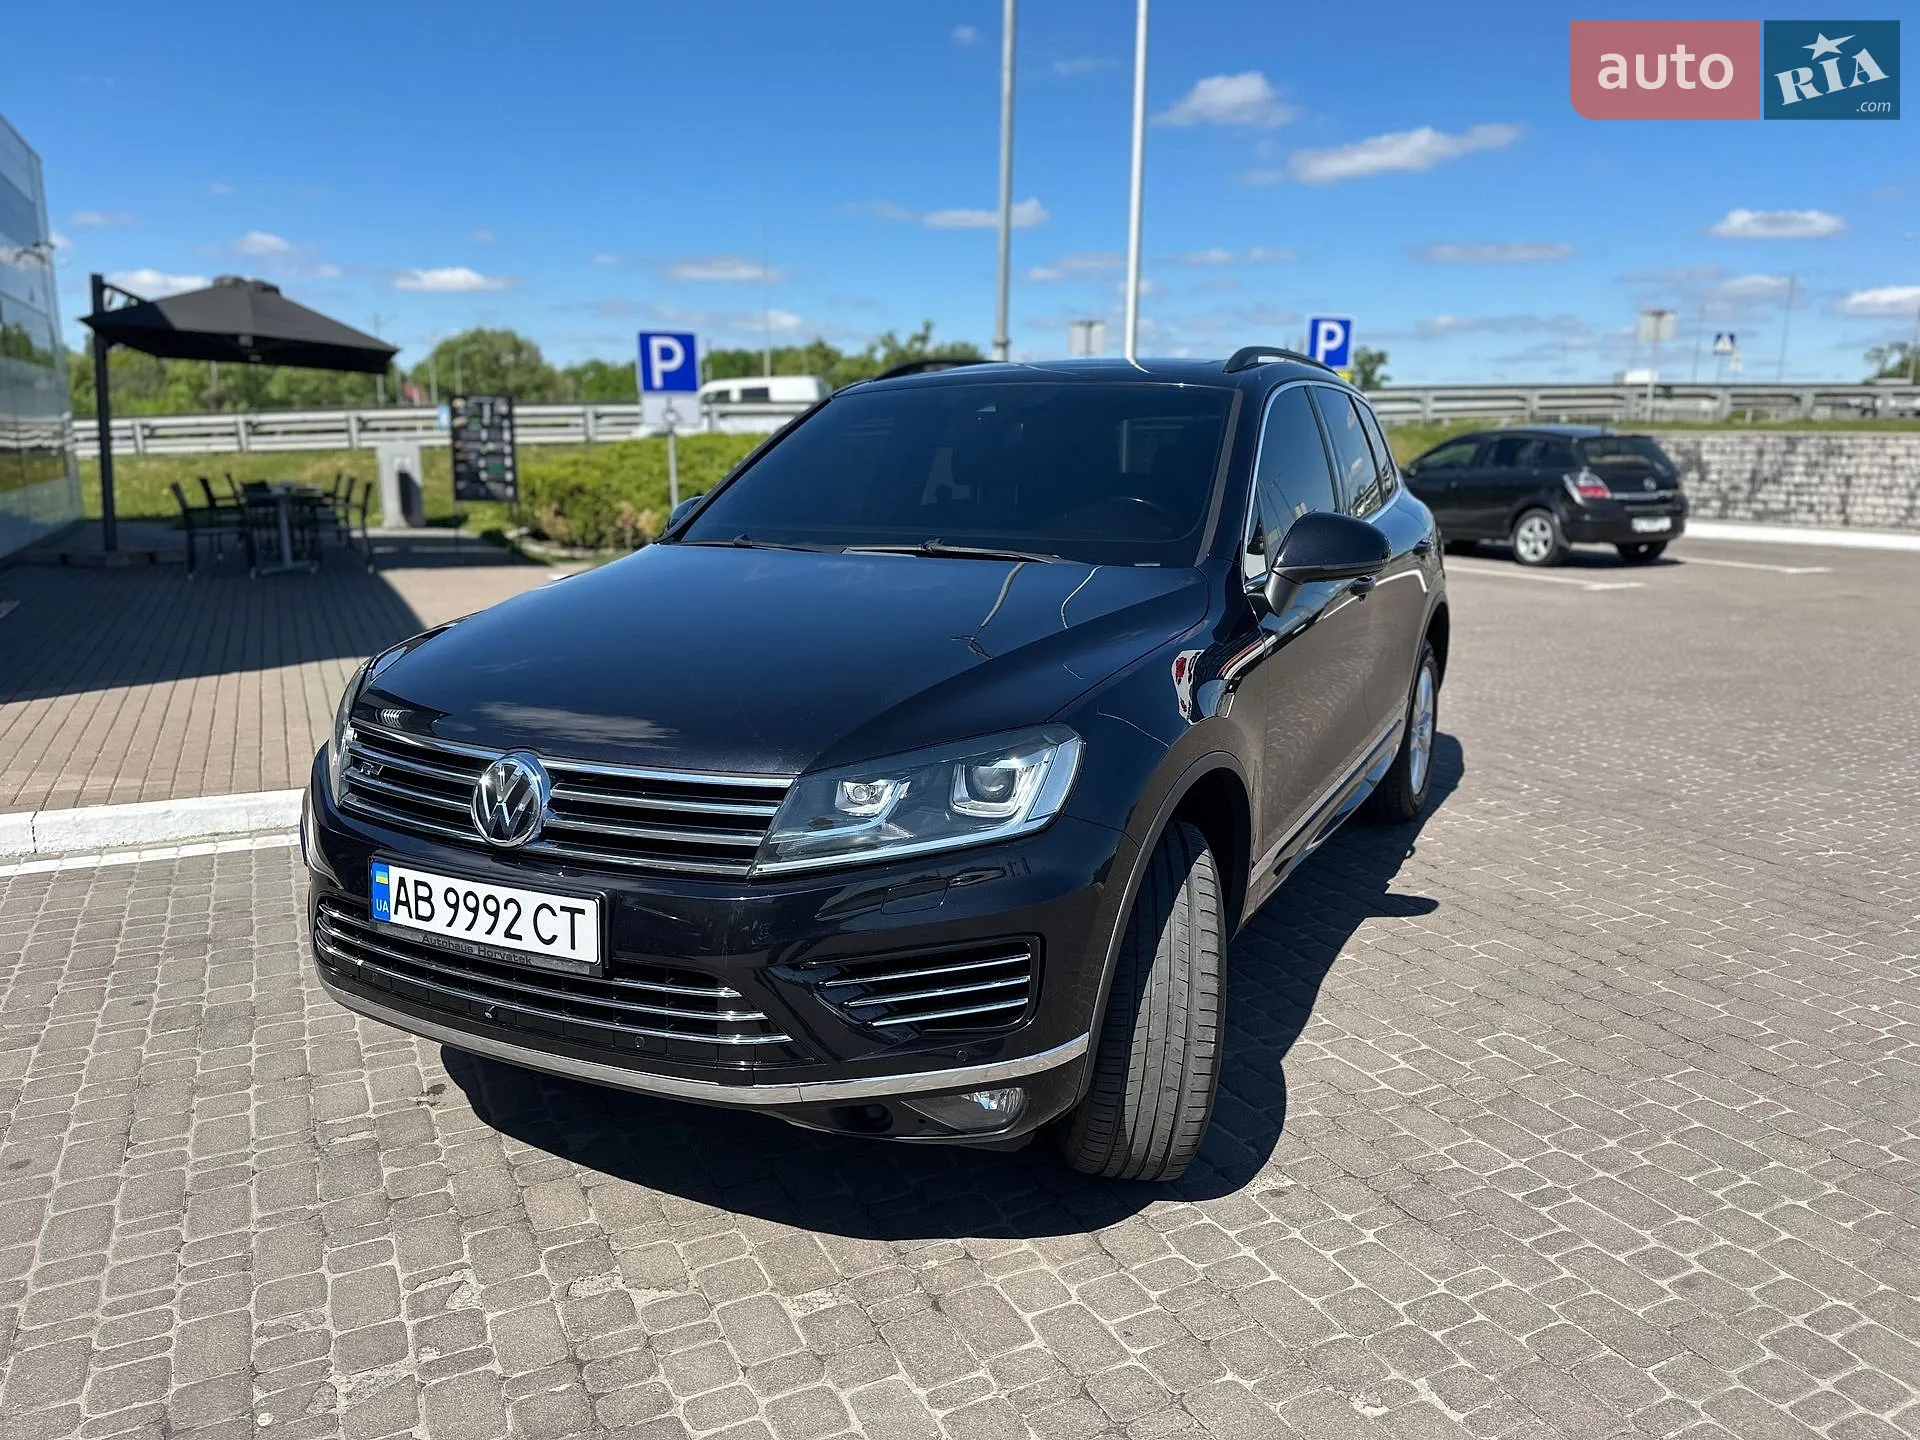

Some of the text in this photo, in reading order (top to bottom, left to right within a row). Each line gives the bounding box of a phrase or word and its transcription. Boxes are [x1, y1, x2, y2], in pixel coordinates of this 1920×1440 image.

[649, 335, 685, 390] P
[1316, 321, 1345, 364] P
[376, 898, 390, 913] UA
[393, 876, 586, 951] AB 9992 CT
[421, 934, 474, 954] Autohaus
